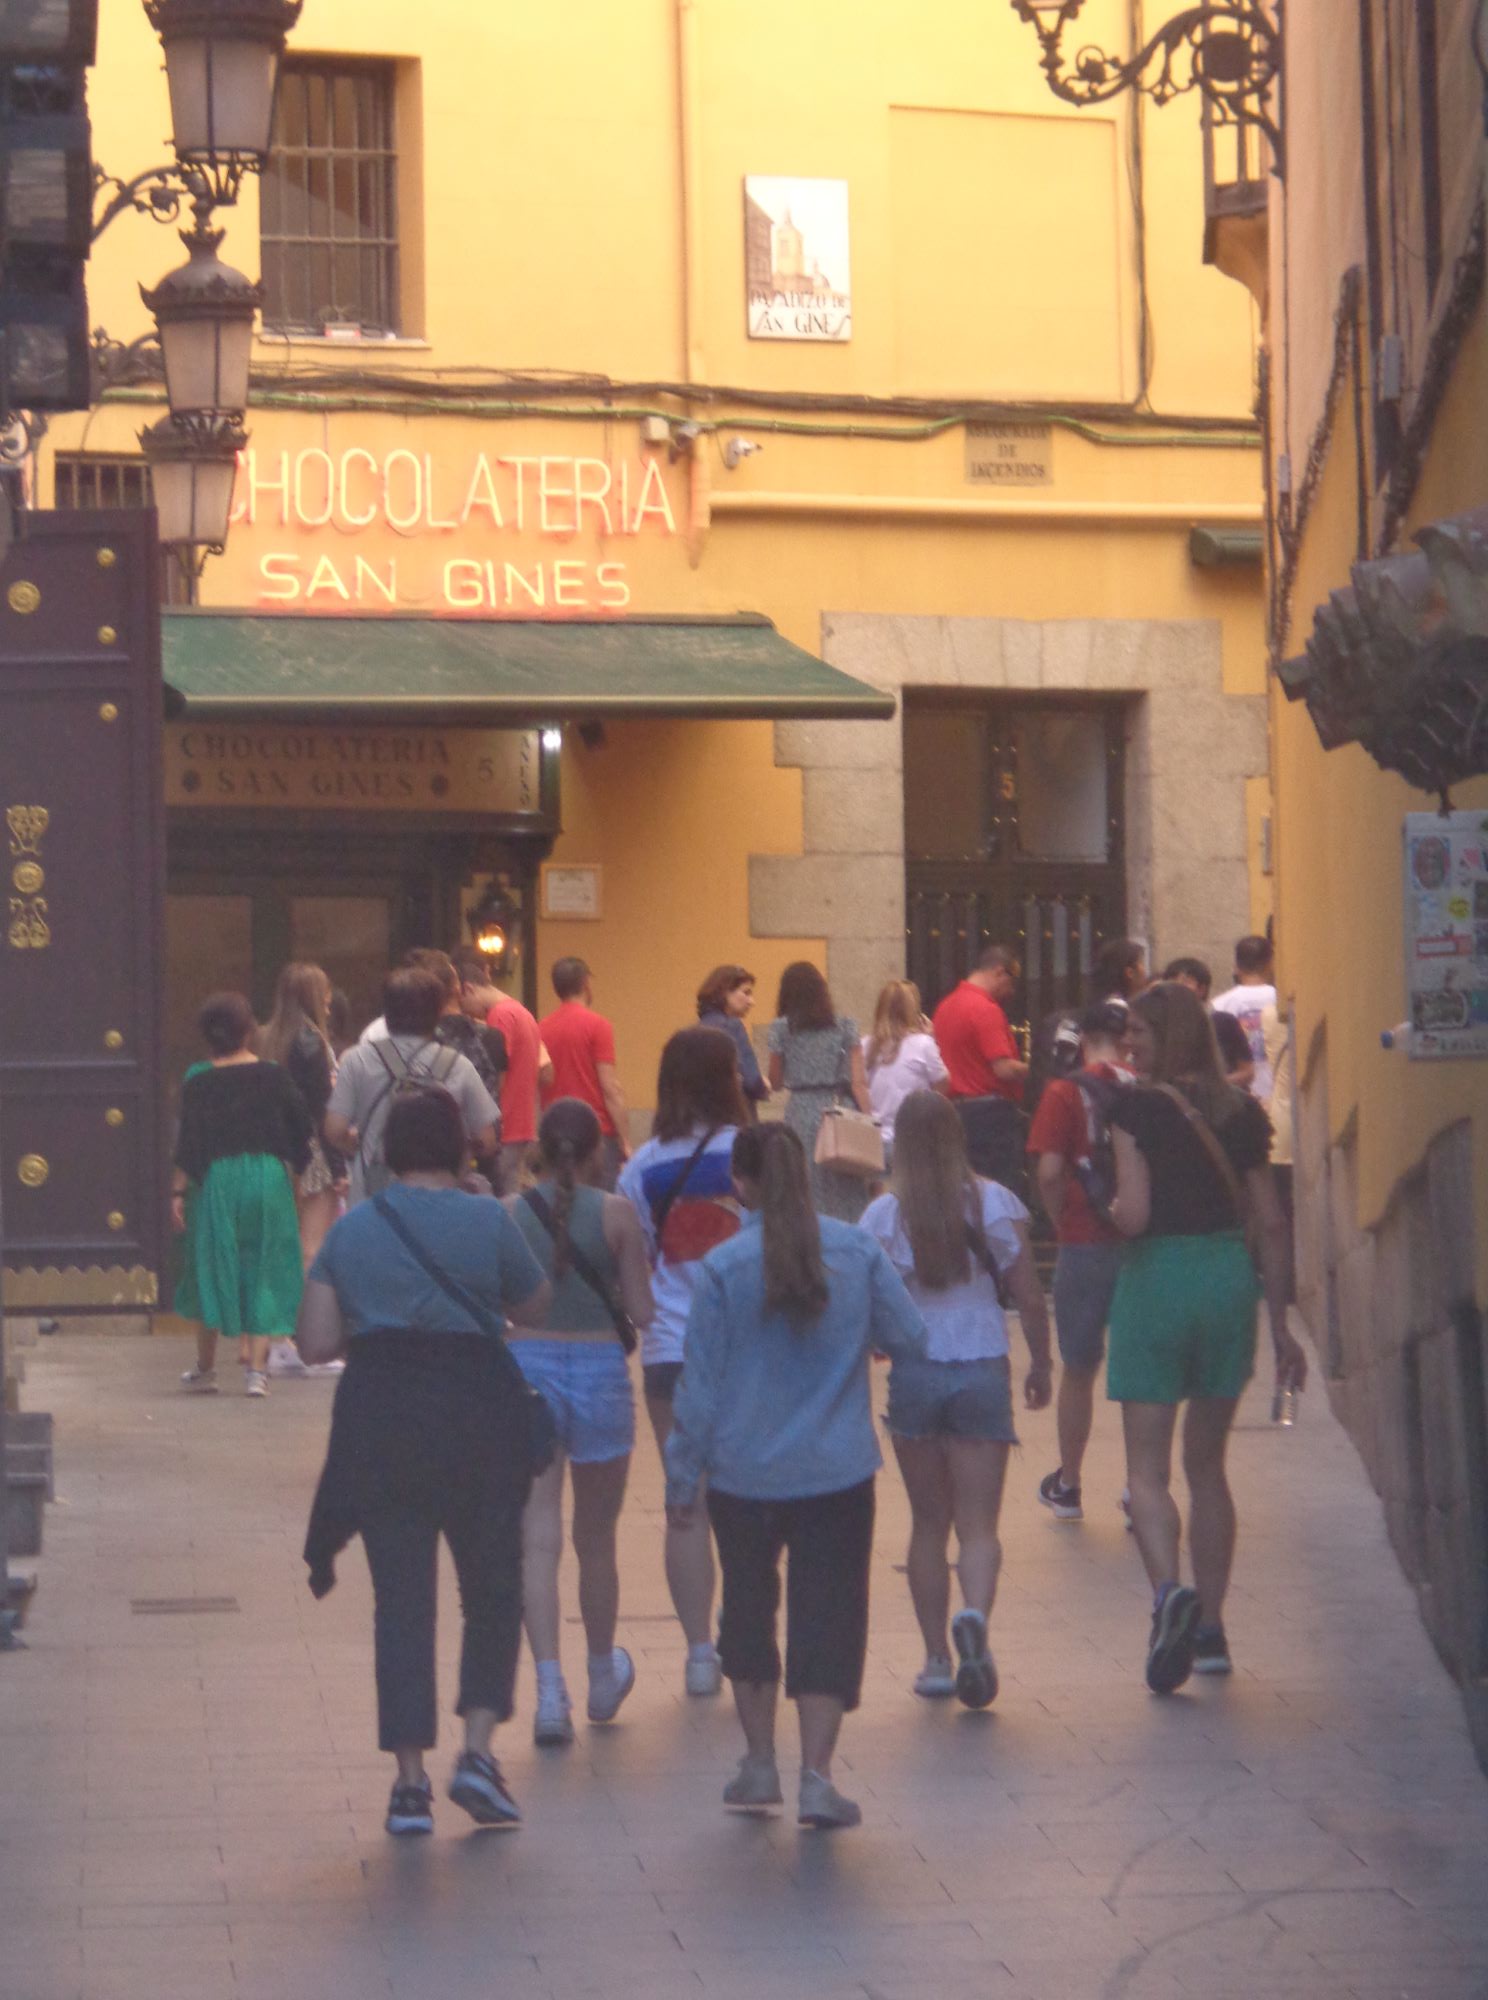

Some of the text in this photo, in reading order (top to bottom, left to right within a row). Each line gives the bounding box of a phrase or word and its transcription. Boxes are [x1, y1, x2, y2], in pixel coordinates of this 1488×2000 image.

[259, 552, 631, 608] SAN GINES
[180, 732, 450, 764] CHOCOLATERIA
[216, 768, 290, 796] SAN
[1001, 771, 1015, 800] 5
